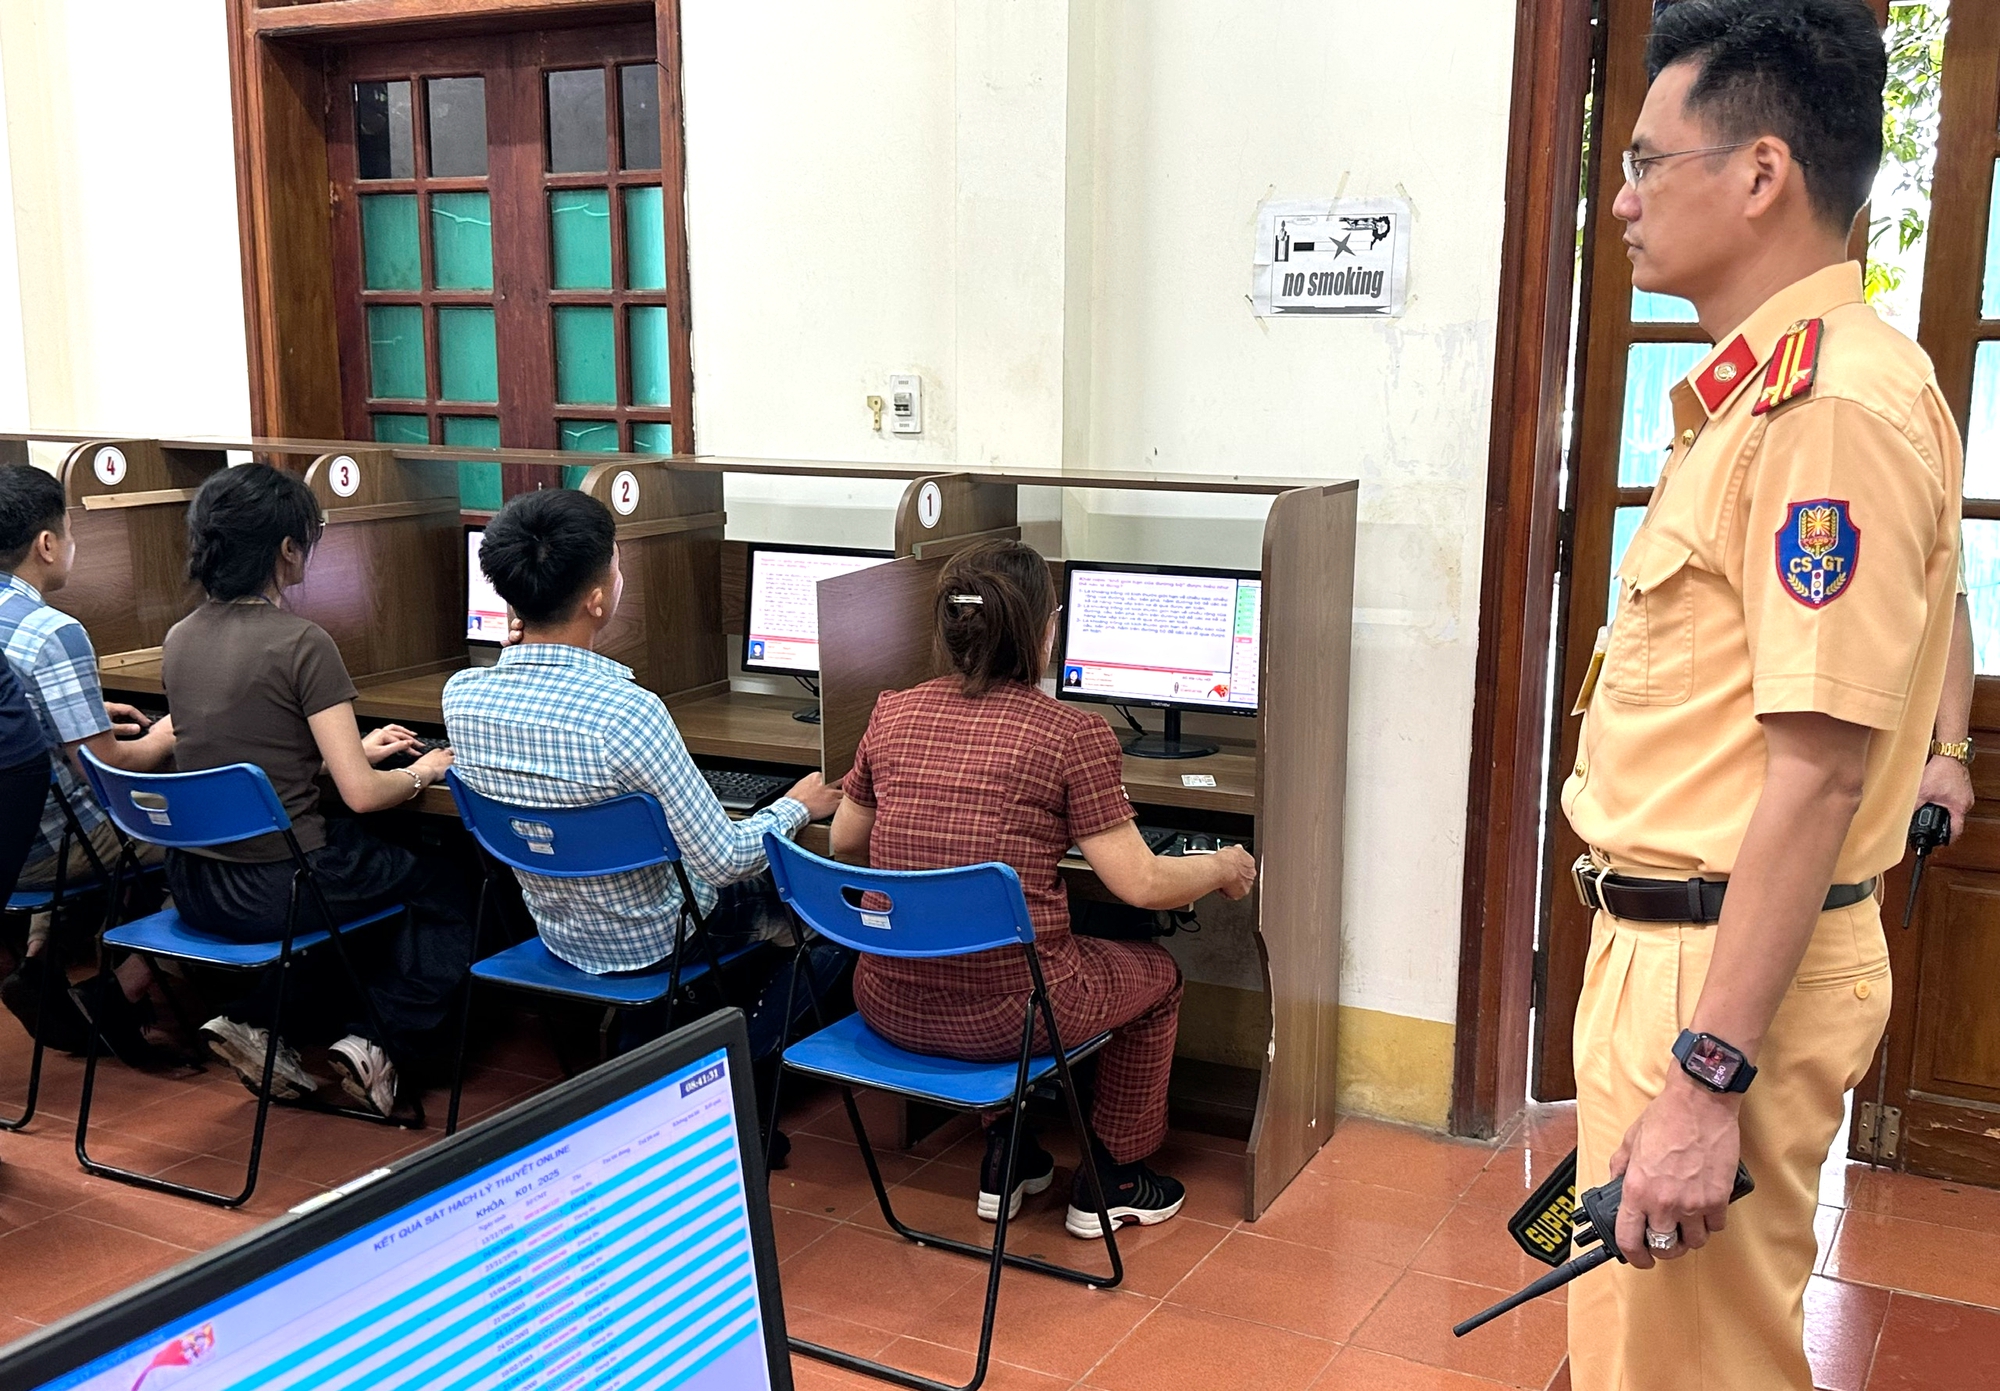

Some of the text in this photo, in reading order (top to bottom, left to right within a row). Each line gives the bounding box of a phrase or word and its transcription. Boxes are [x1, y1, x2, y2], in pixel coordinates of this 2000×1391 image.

[1282, 267, 1384, 298] no smoking
[106, 456, 116, 476] 4
[340, 466, 349, 487] 3
[621, 481, 630, 503] 2
[926, 492, 933, 517] 1
[1789, 555, 1845, 574] CS GT
[536, 1144, 571, 1167] ONLINE
[515, 1183, 533, 1198] K01
[537, 1168, 561, 1186] 2025
